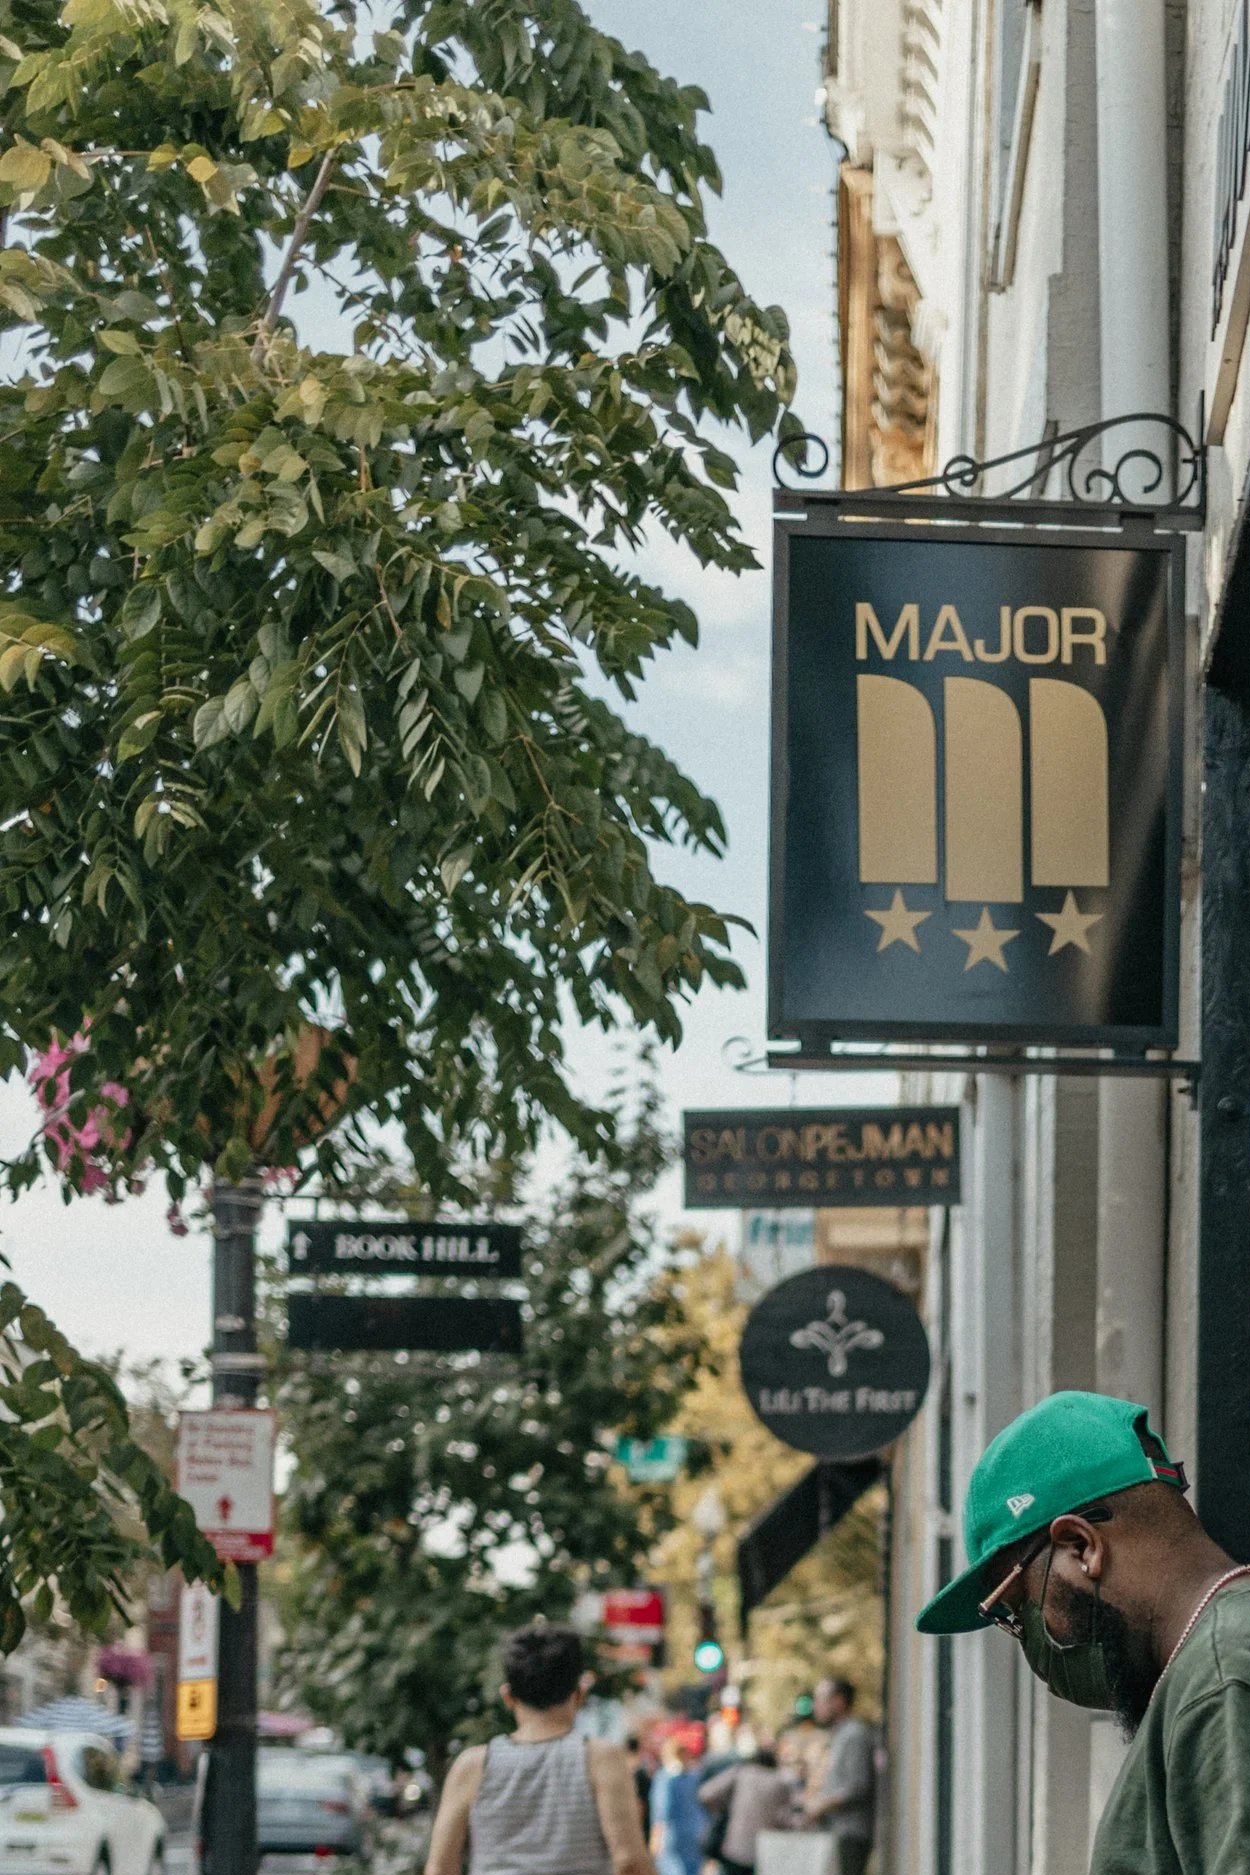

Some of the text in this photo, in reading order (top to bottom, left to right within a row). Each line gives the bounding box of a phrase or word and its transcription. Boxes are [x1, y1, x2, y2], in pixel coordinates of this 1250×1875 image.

[854, 602, 1108, 665] MAJOR
[335, 1233, 501, 1264] BOOK HILL
